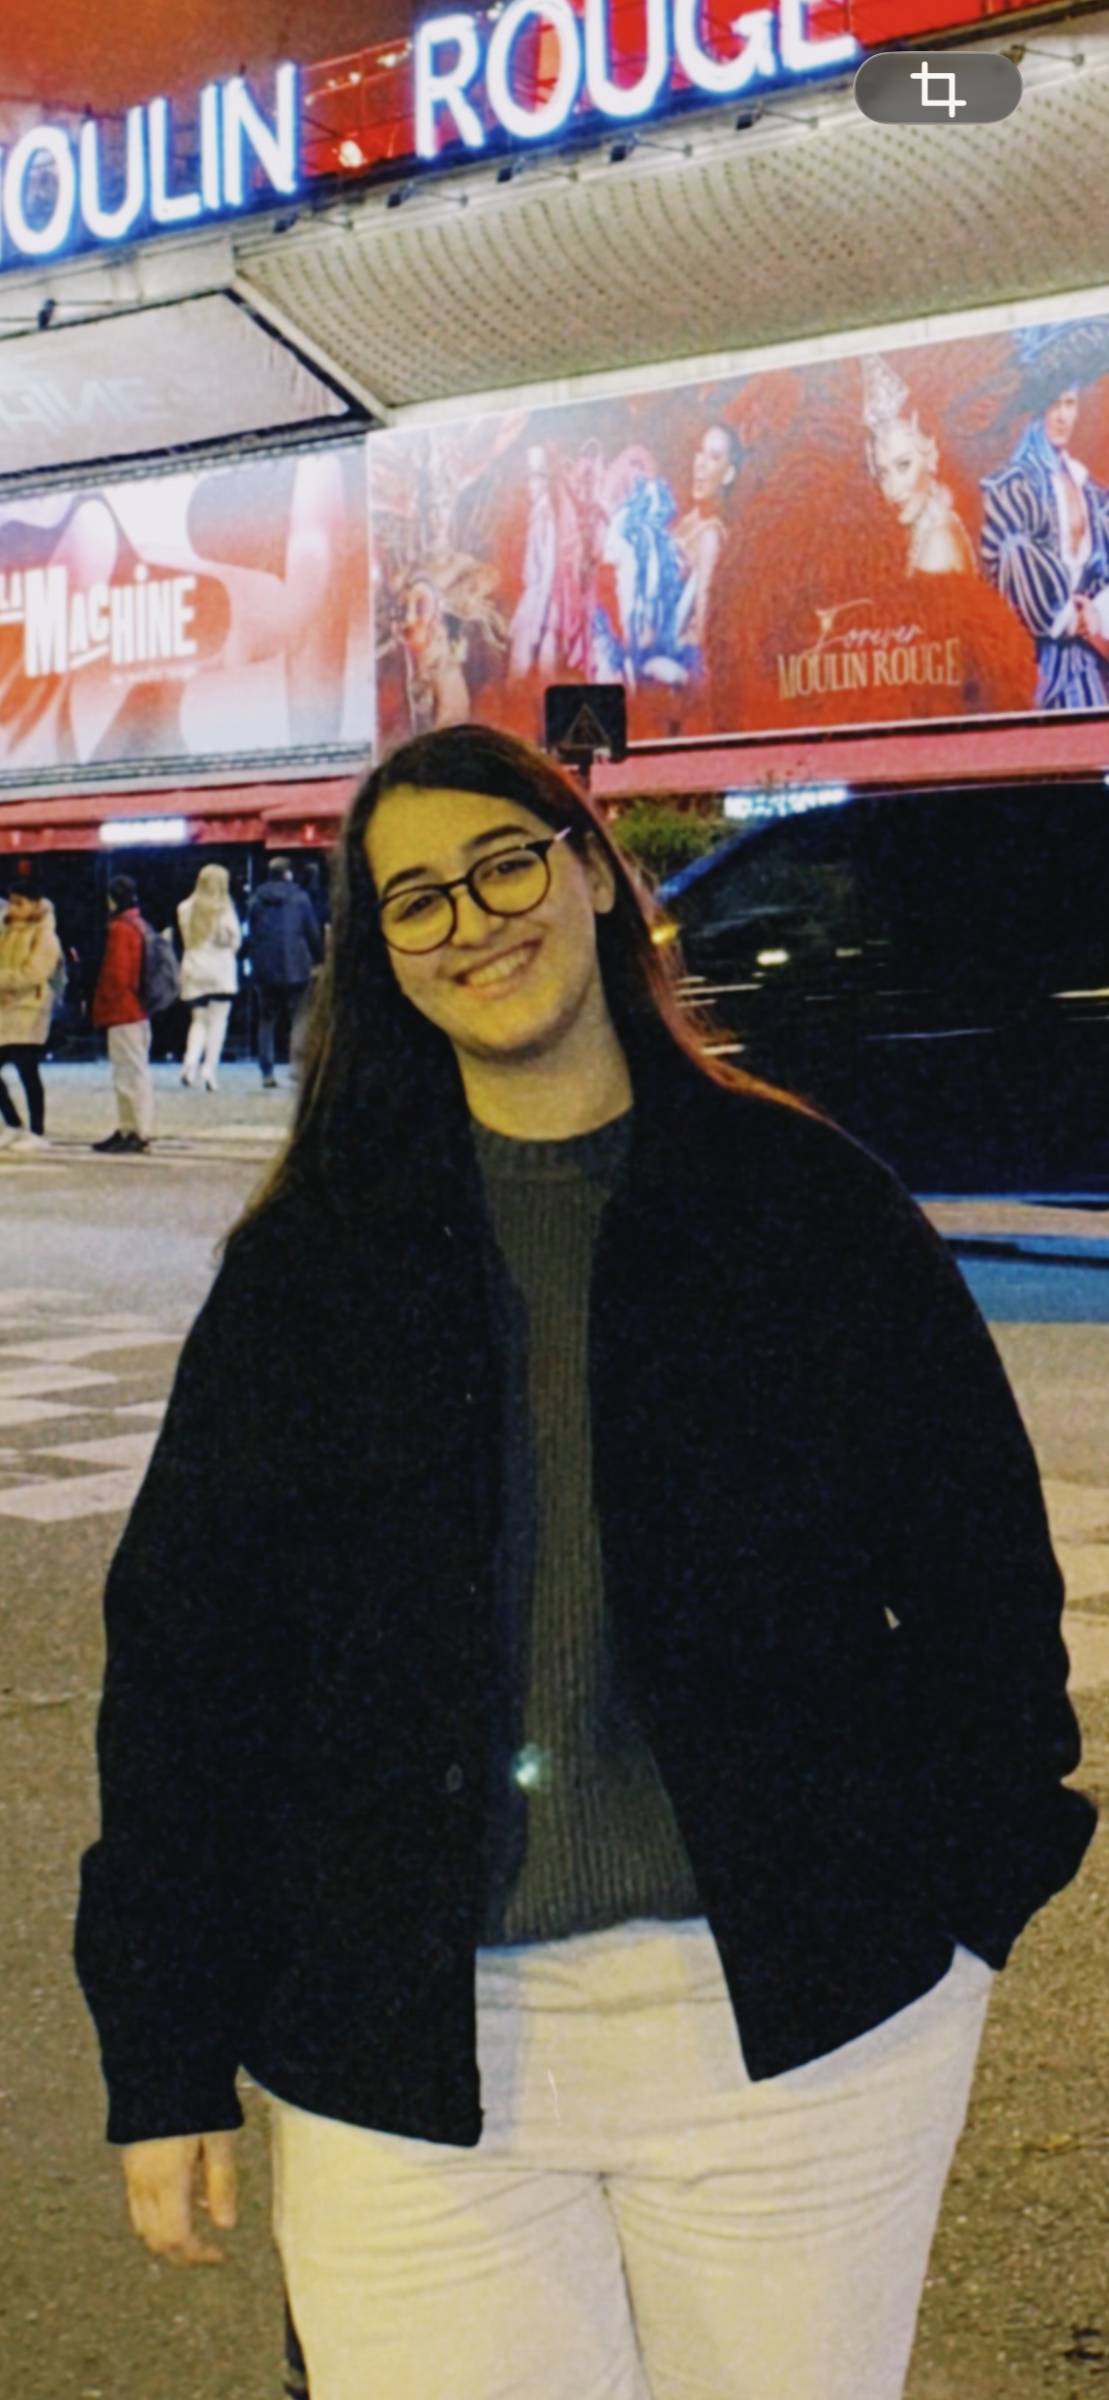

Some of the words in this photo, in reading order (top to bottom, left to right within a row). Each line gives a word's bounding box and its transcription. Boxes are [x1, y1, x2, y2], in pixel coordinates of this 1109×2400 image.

[0, 60, 298, 256] OULIN
[801, 597, 923, 656] Forever
[777, 650, 867, 699] MOULIN
[873, 637, 961, 687] ROUGE
